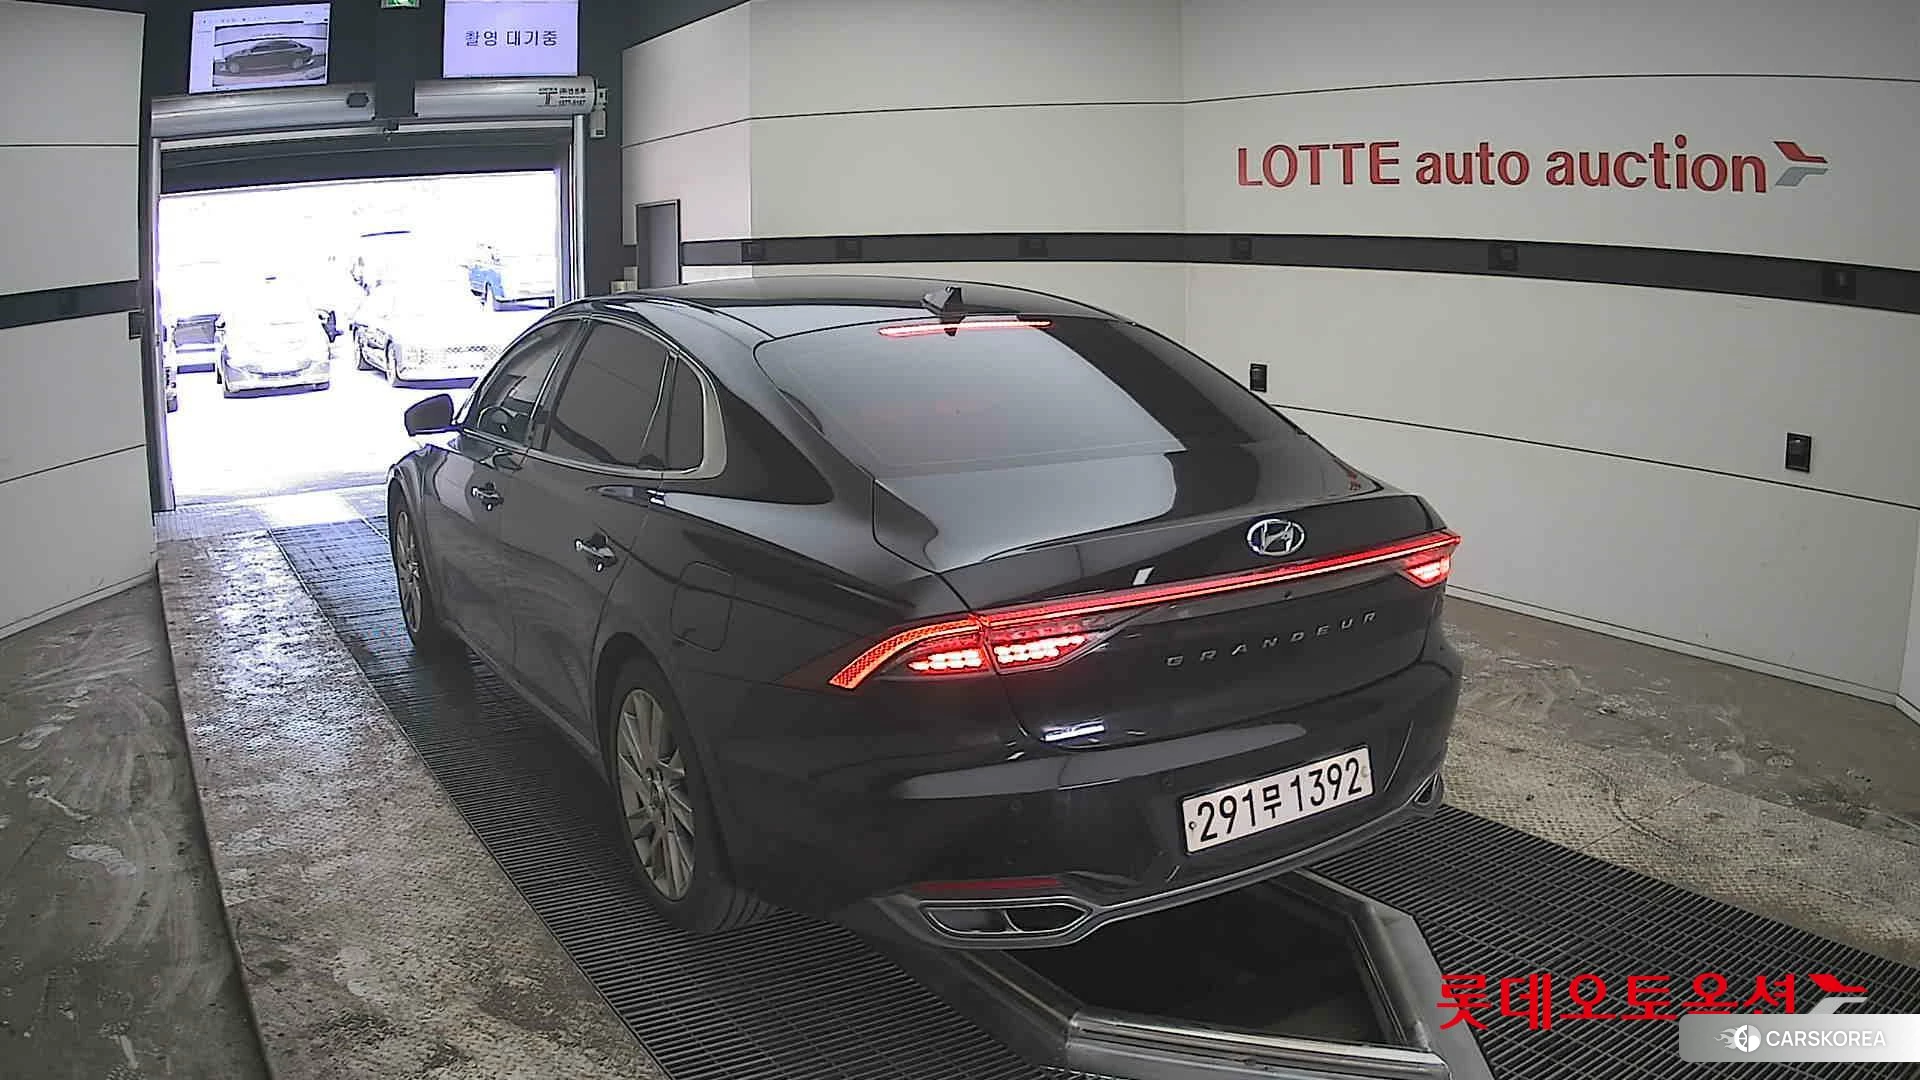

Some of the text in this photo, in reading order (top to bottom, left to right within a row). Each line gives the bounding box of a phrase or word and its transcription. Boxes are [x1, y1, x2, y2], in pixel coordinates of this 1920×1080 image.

[465, 30, 558, 47] 촬영 대기중
[1238, 134, 1768, 193] LOTTE auto auction
[1166, 611, 1377, 667] GRANDEUR
